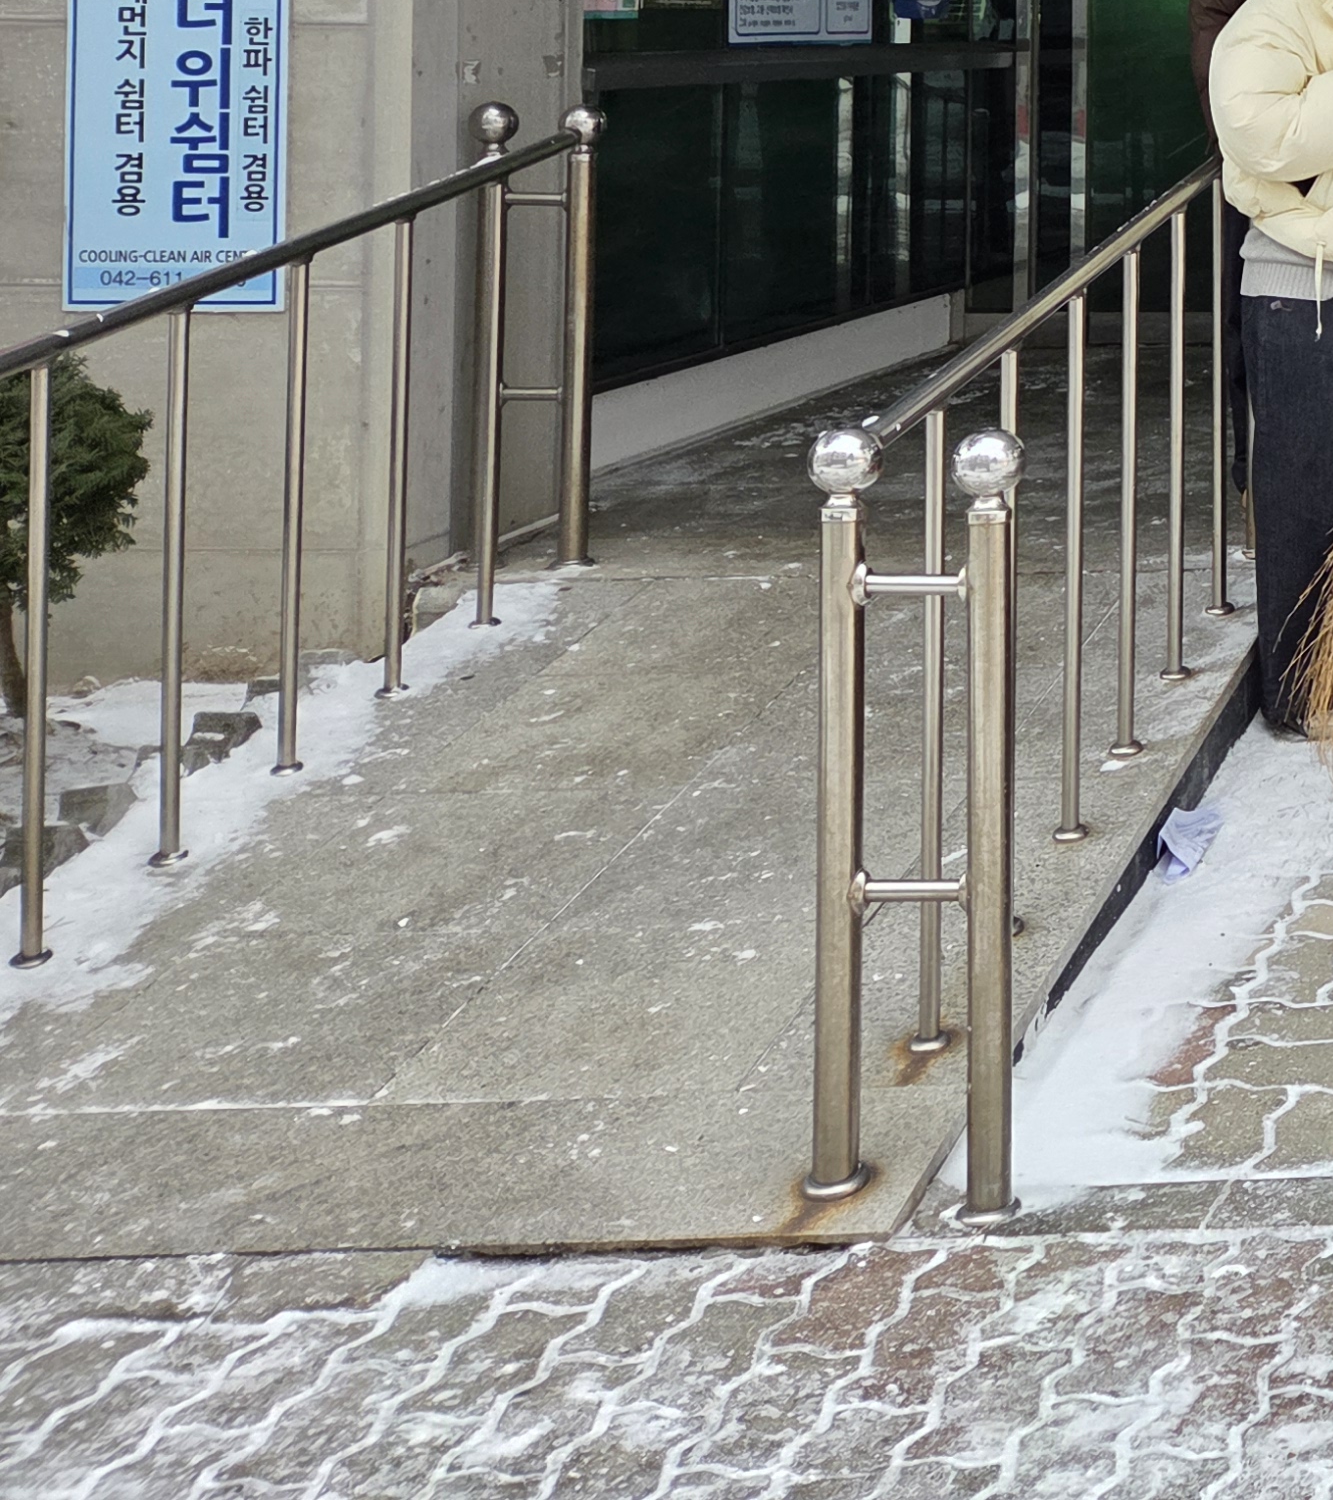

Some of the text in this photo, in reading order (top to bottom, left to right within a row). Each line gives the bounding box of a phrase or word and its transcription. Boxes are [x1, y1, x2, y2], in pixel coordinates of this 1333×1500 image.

[114, 79, 145, 143] 쉼터
[239, 16, 274, 213] 한파 쉼터 겸용
[111, 152, 146, 217] 겸용
[78, 249, 186, 264] COOLING-CLEAN
[189, 250, 213, 263] AIR
